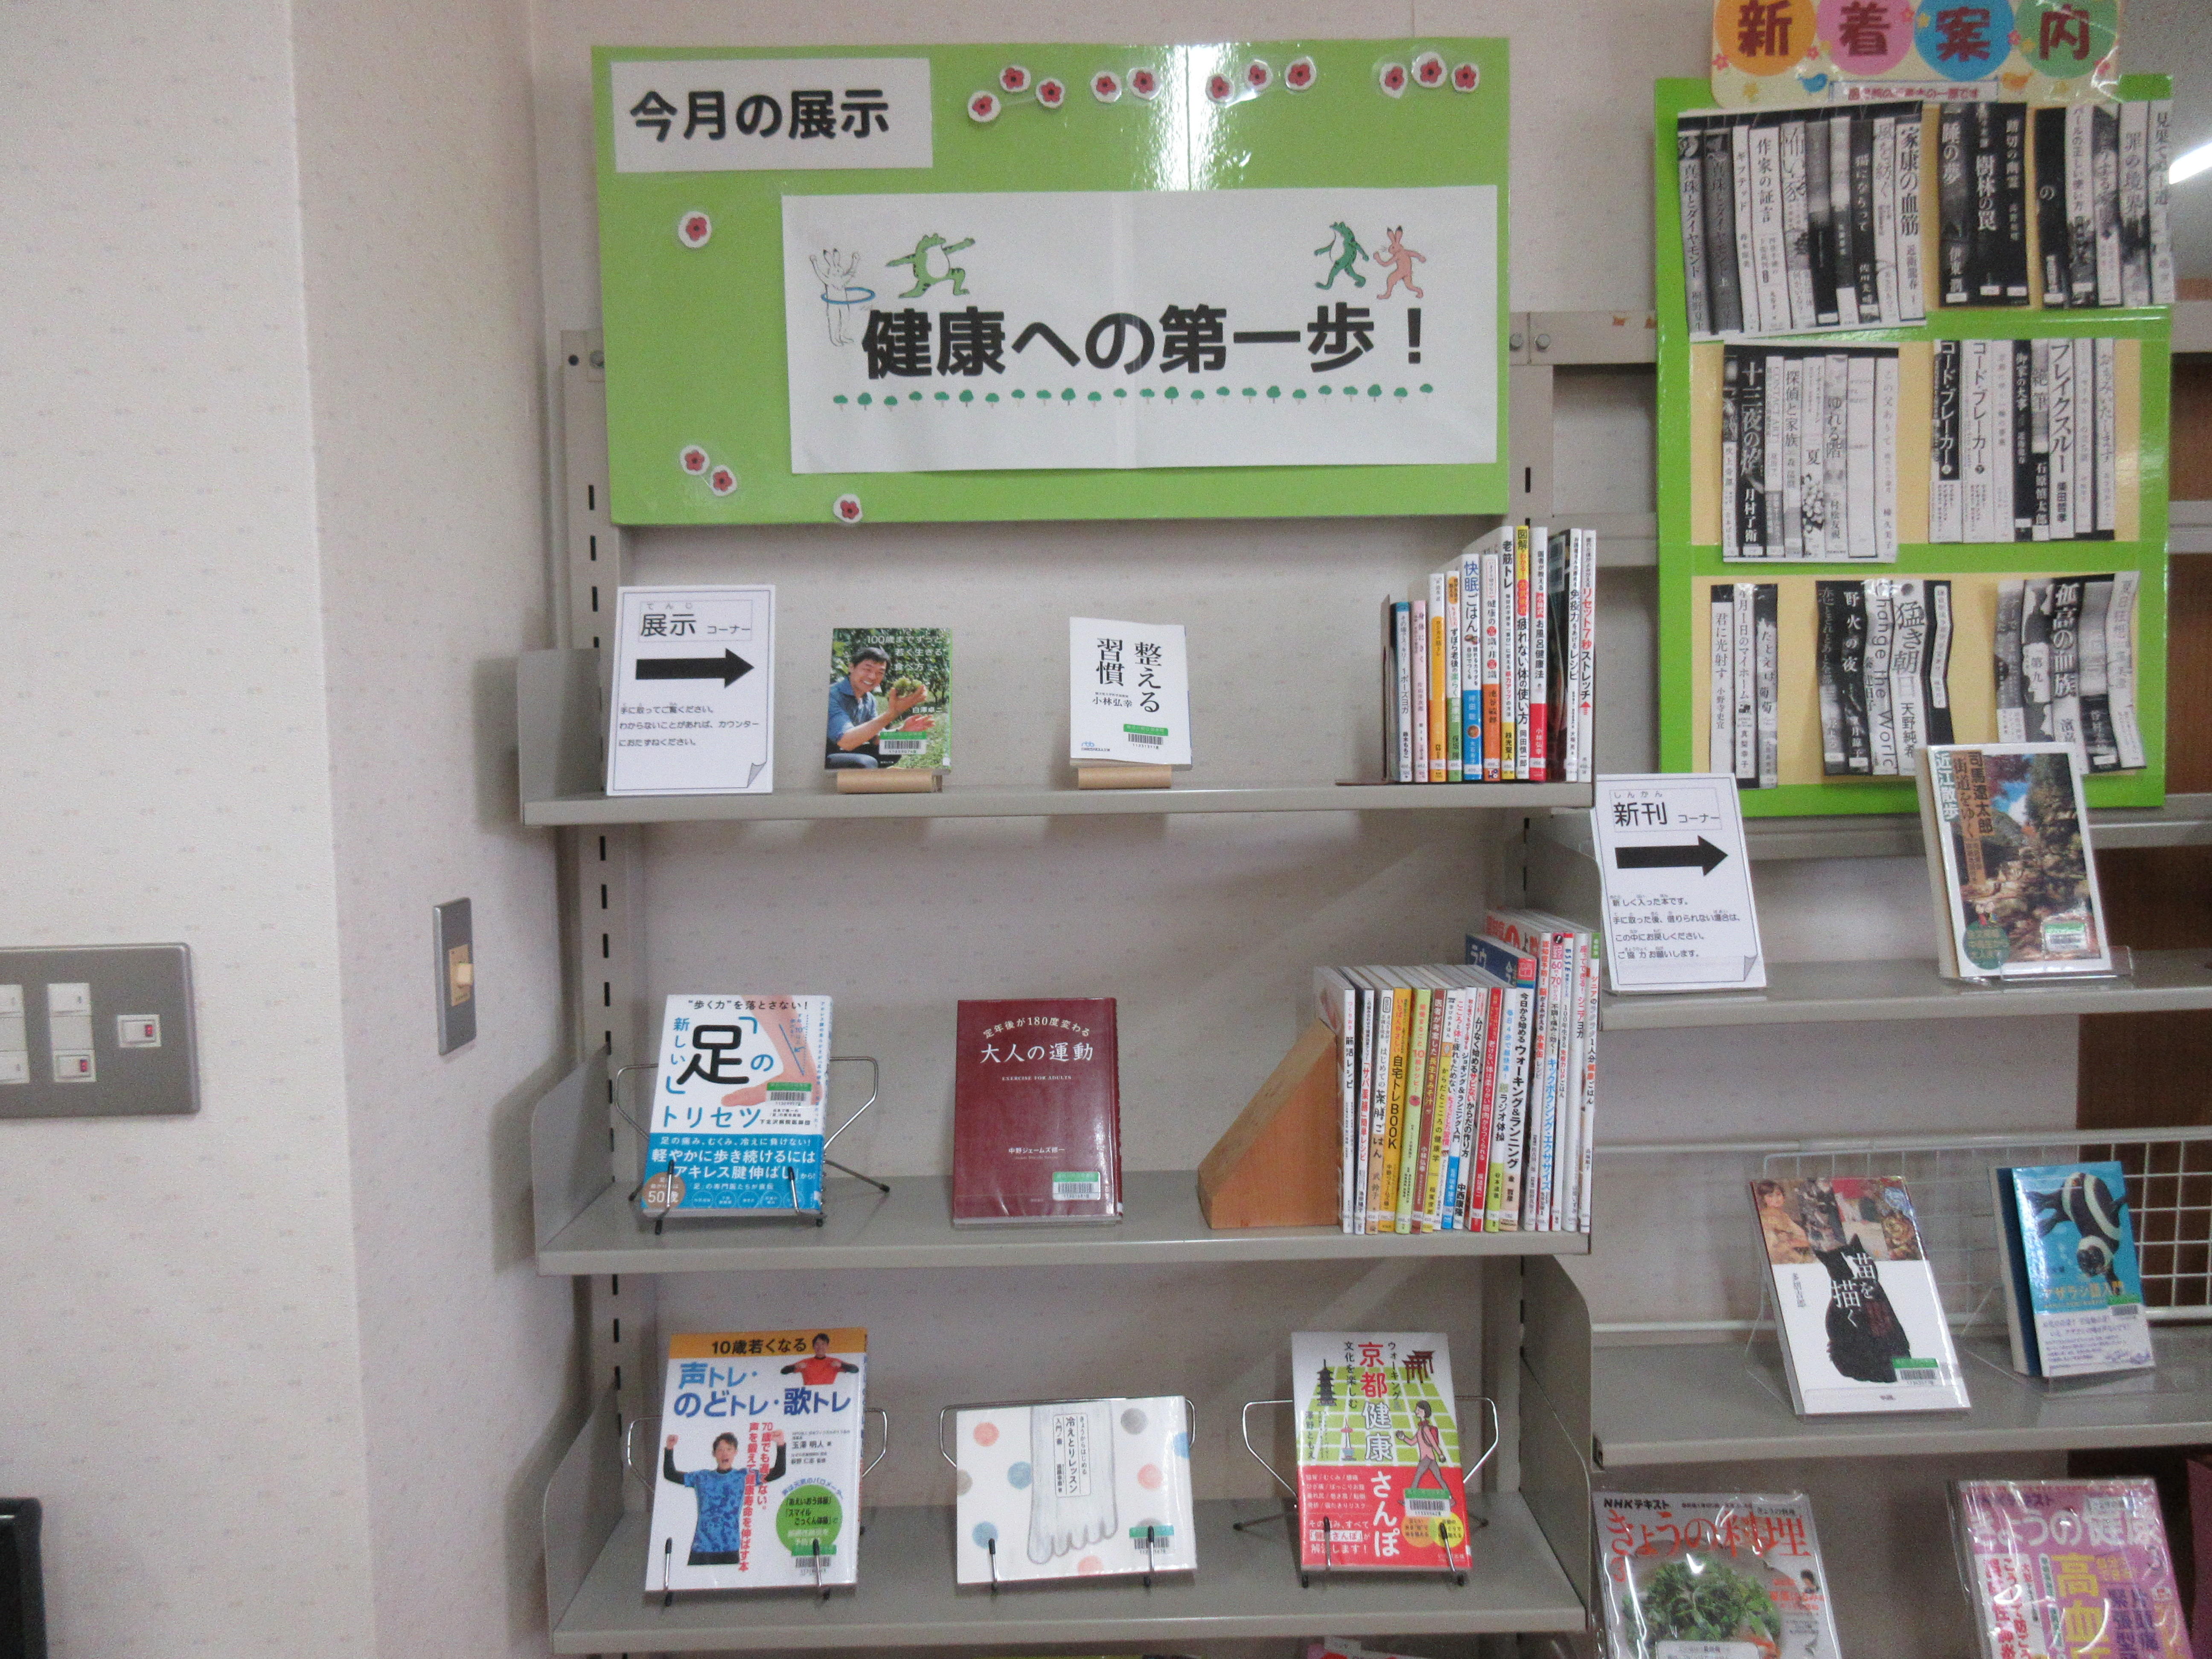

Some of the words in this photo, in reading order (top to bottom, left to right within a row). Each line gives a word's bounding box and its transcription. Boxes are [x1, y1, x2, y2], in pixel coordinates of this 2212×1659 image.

[1737, 0, 2091, 61] 新着案内
[629, 89, 891, 142] 今月の展示
[1757, 139, 1774, 223] 作家の証言
[1899, 127, 1919, 237] 家康の血筋
[1785, 370, 1800, 448] 探偵と家族
[1940, 342, 1956, 464] コード・ブレーカー
[1972, 342, 1988, 464] コード・ブレーカー
[1806, 448, 1821, 466] 夏
[1502, 541, 1512, 589] 老筋トレ
[1464, 561, 1479, 632] 快眠ごはん
[640, 613, 696, 637] 展示
[707, 624, 751, 634] コーナー
[1535, 619, 1544, 679] お風呂健康法
[1580, 588, 1593, 701] リセット7秒ストレッチ
[1714, 613, 1728, 680] 君に光射す
[1842, 591, 1862, 673] 野火の夜
[896, 649, 944, 657] 若く生きる
[1095, 637, 1125, 687] 習慣
[1134, 641, 1162, 713] 整える
[1515, 617, 1529, 725] 疲れない体の使い方
[1759, 629, 1776, 715] たとえば葡萄
[619, 720, 760, 730] わからないことがあれば、カウンター
[1092, 696, 1133, 709] 小林弘幸
[619, 738, 697, 747] におたずねください。
[1935, 752, 1959, 821] 近江散歩
[1953, 758, 1975, 838] 街道をゆく
[1967, 751, 1994, 834] 司馬遼太郎
[1613, 802, 1668, 827] 新刊
[1677, 814, 1720, 824] コーナー
[1612, 897, 1688, 906] 新しく入った本です。
[1615, 933, 1704, 941] この中にお戻しください。
[671, 1017, 690, 1065] 新しい
[980, 1042, 1093, 1064] 大人の運動
[983, 1016, 1090, 1039] 定年後が180度変わる
[750, 1054, 774, 1071] の
[664, 1105, 761, 1128] トリセツ
[1388, 1055, 1403, 1150] 自宅トレBOOK
[651, 1148, 816, 1164] 軽やかに歩き続けるには
[711, 1338, 807, 1355] 10歳若くなる
[1344, 1341, 1358, 1409] 文化を楽しむ
[673, 1387, 852, 1417] のどトレ・歌トレ
[1065, 1417, 1078, 1495] 冷えとりレッスン
[1080, 1415, 1088, 1476] きょうからはじめる
[1603, 1498, 1670, 1510] NHKテキスト
[1607, 1508, 1812, 1558] きょうの料理
